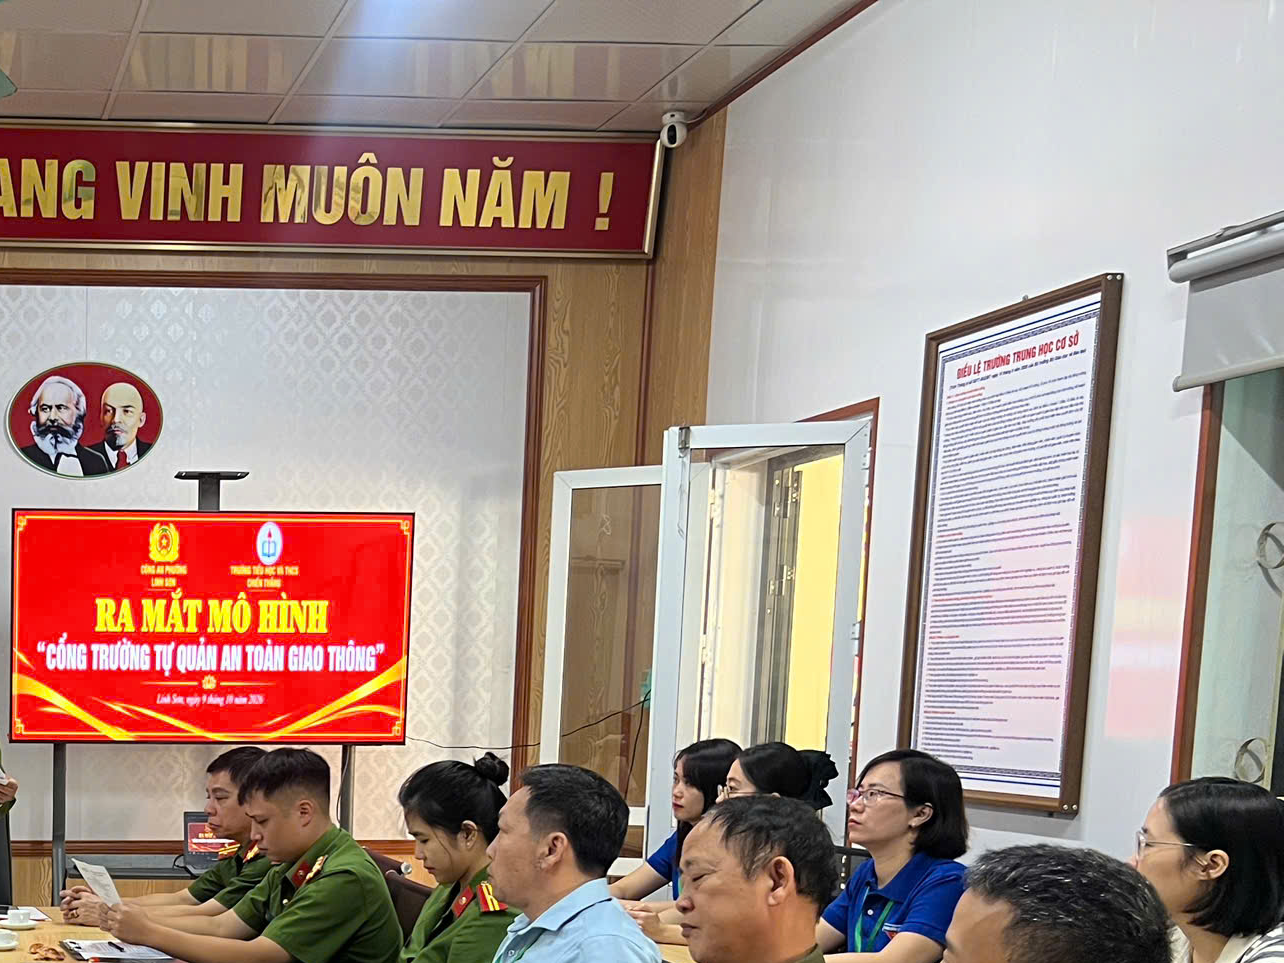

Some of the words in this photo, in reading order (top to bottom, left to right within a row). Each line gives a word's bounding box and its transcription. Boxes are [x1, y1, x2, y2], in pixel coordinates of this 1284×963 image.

[117, 162, 243, 222] VINH
[262, 152, 425, 226] MUÔN
[440, 157, 571, 230] NĂM
[1012, 346, 1037, 362] TRUNG
[1038, 341, 1053, 358] HỌC
[95, 598, 135, 633] RA
[141, 588, 203, 633] MẮT
[207, 591, 251, 634] MÔ
[258, 591, 329, 634] HÌNH
[91, 637, 150, 671] TRƯỜNG
[154, 641, 175, 677] TỰ
[176, 636, 218, 673] QUẢN
[220, 644, 242, 671] AN
[246, 639, 284, 671] TOÀN
[288, 645, 324, 672] GIAO
